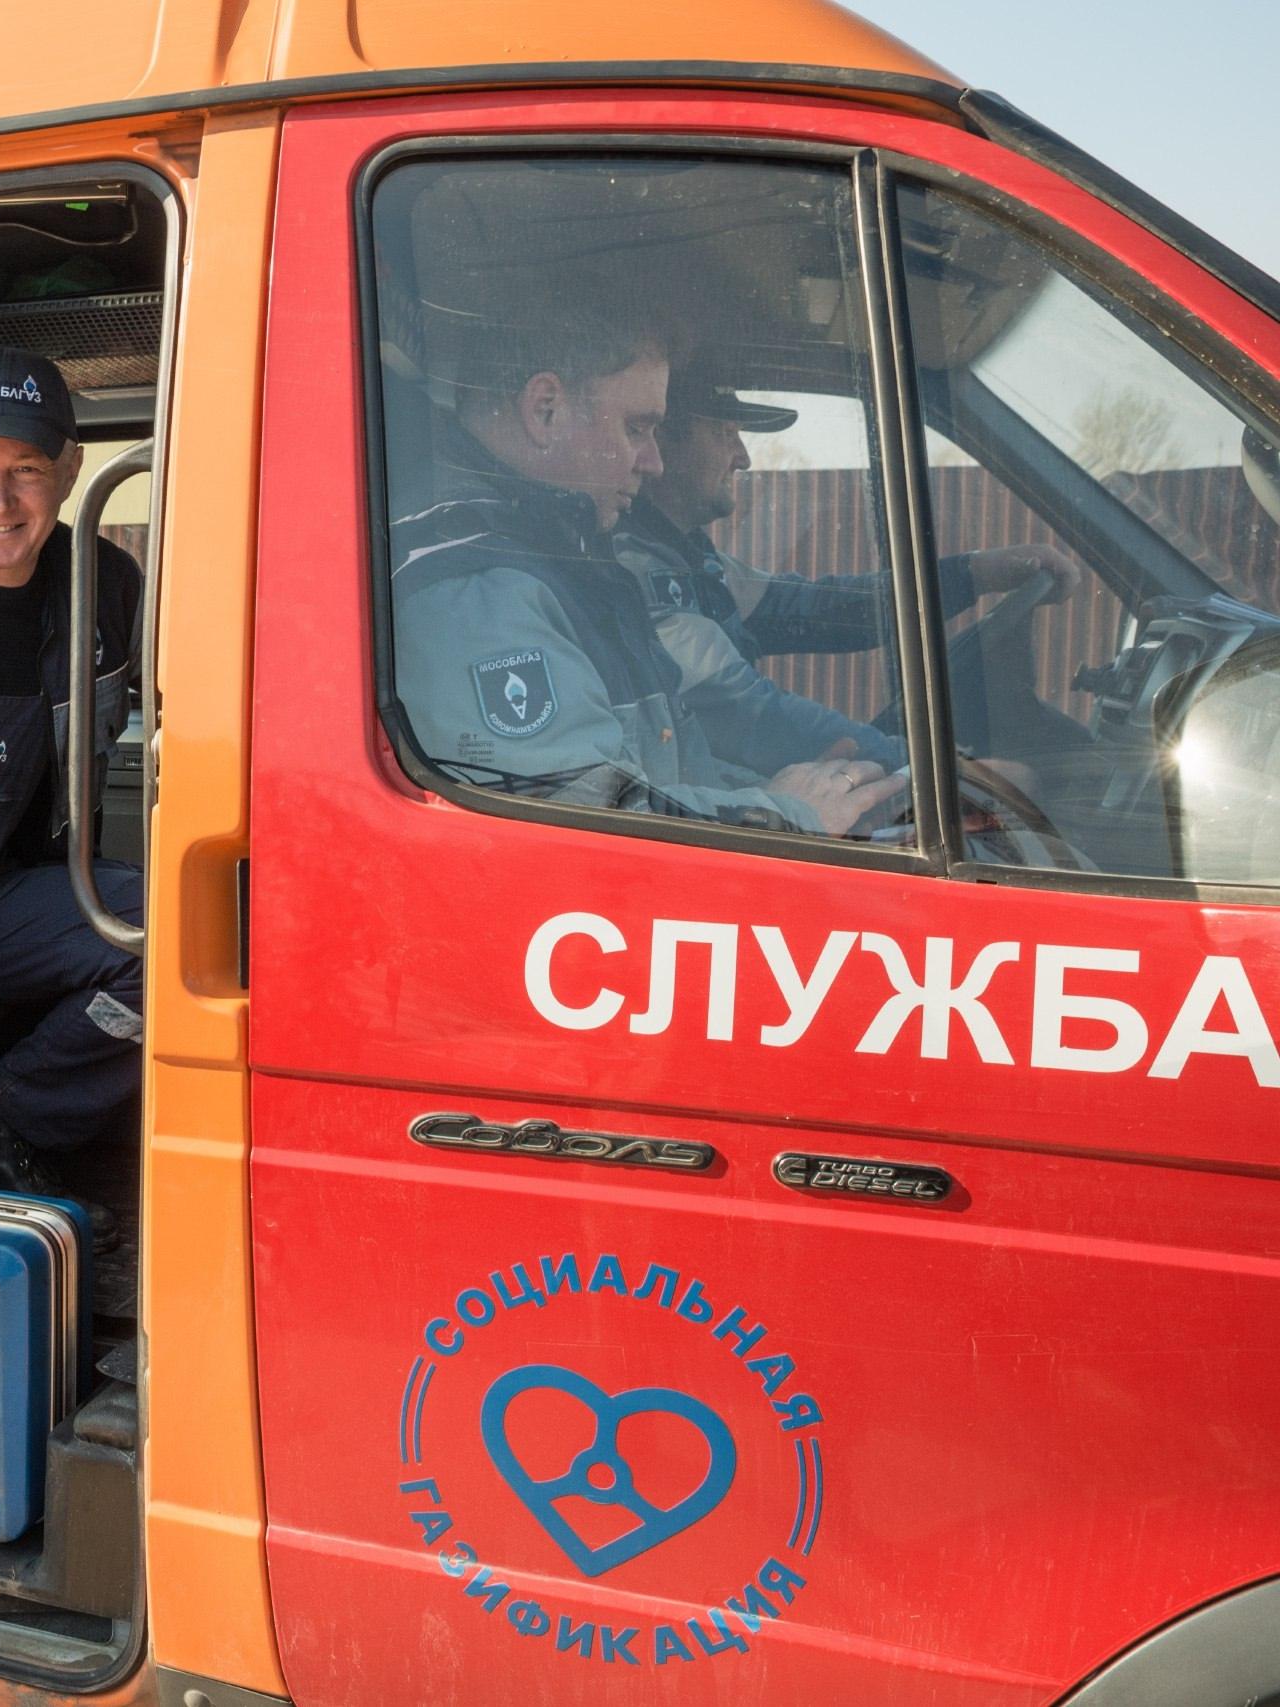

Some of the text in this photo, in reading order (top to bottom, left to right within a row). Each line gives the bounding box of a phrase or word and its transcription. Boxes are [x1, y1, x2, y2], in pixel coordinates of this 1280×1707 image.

[480, 652, 541, 673] МОСОБЛГАЗ
[524, 912, 1280, 1089] СЛУЖБА
[811, 1171, 943, 1198] DIESEL
[818, 1161, 894, 1176] TURBO
[425, 1254, 824, 1431] СОЦИАЛЬНАЯ
[400, 1478, 808, 1666] ГАЗИФИКАЦИЯ
